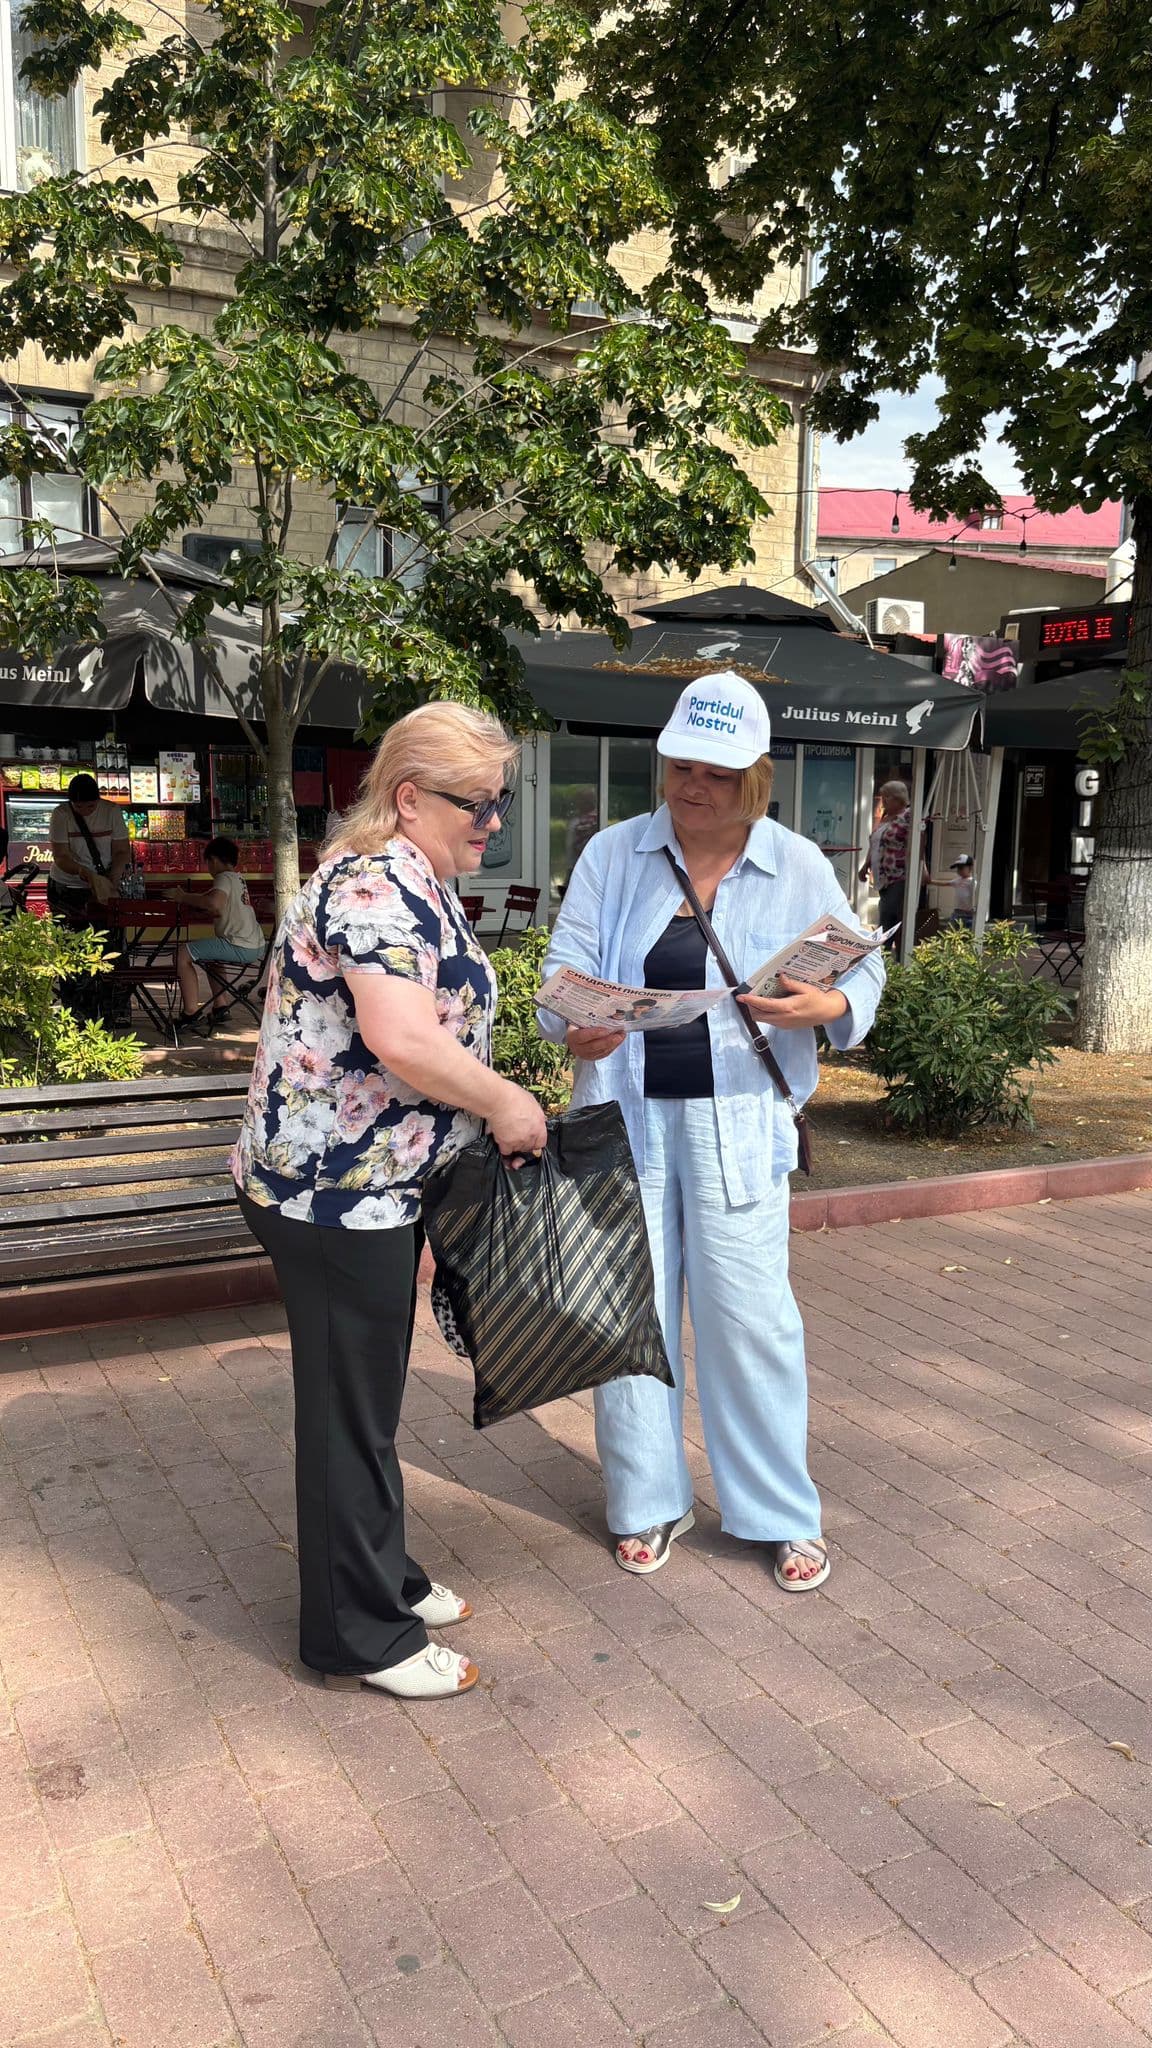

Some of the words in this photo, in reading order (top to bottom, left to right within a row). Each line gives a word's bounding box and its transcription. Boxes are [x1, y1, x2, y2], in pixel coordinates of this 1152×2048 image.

[22, 665, 71, 683] Meinl
[689, 696, 744, 720] Partidul
[781, 706, 841, 722] Julius
[845, 710, 898, 727] Meinl
[687, 712, 737, 735] Nostru
[804, 744, 852, 757] ПРОШИВКА
[566, 969, 621, 992] СИНДРОМ
[622, 988, 672, 998] ПИОНЕРА
